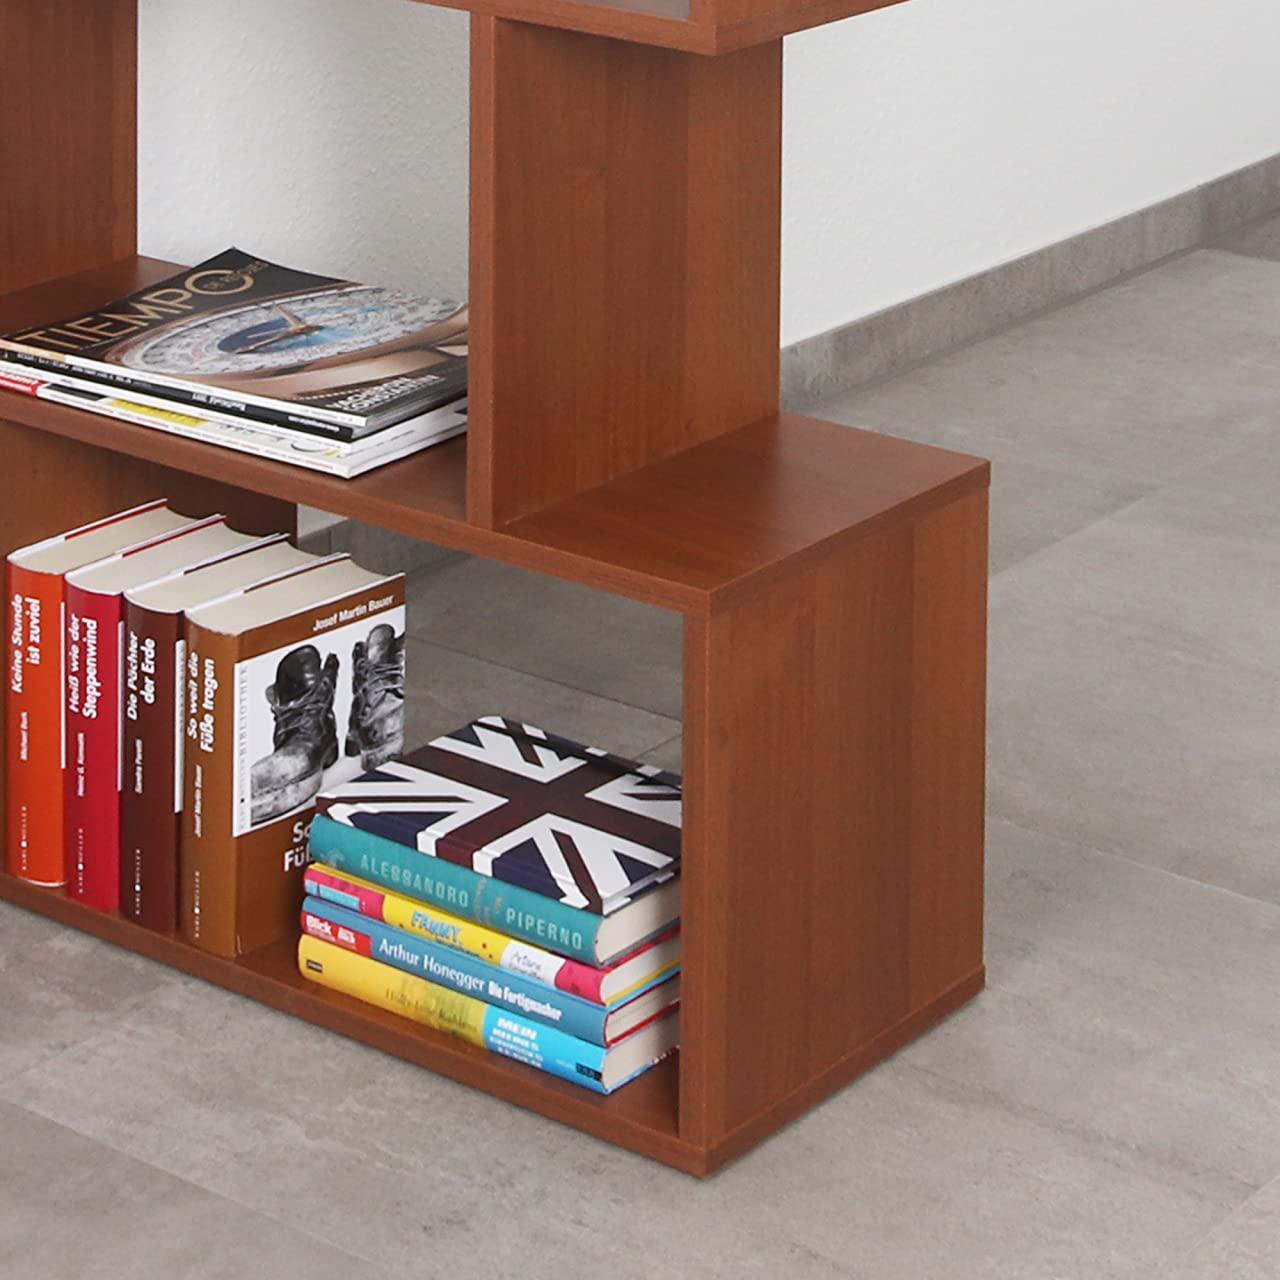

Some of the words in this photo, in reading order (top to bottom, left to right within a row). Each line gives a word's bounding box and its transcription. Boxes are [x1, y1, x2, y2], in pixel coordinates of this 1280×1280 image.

[14, 269, 255, 350] TIEMPO
[11, 594, 23, 647] Stunde
[24, 597, 40, 644] zuviel
[68, 614, 80, 642] der
[313, 613, 338, 632] Josef
[339, 604, 368, 622] Martin
[368, 594, 395, 612] Bauer
[11, 649, 23, 693] Keine
[26, 646, 40, 665] ist
[69, 644, 80, 671] wie
[82, 617, 102, 719] Steppenwind
[127, 631, 139, 691] Pächter
[140, 638, 156, 674] Erde
[188, 651, 199, 678] die
[69, 675, 79, 713] Heiß
[140, 676, 155, 704] der
[188, 680, 199, 714] weit
[202, 658, 218, 710] tragen
[127, 693, 138, 721] Die
[239, 666, 248, 757] BIBLIOTHEK
[187, 718, 197, 740] So
[199, 713, 214, 753] Füße
[360, 854, 469, 909] ALESSANDRO
[412, 910, 463, 942] FANNY
[506, 908, 583, 951] PIPERNO
[379, 938, 420, 966] Arthur
[423, 954, 485, 991] Honegger
